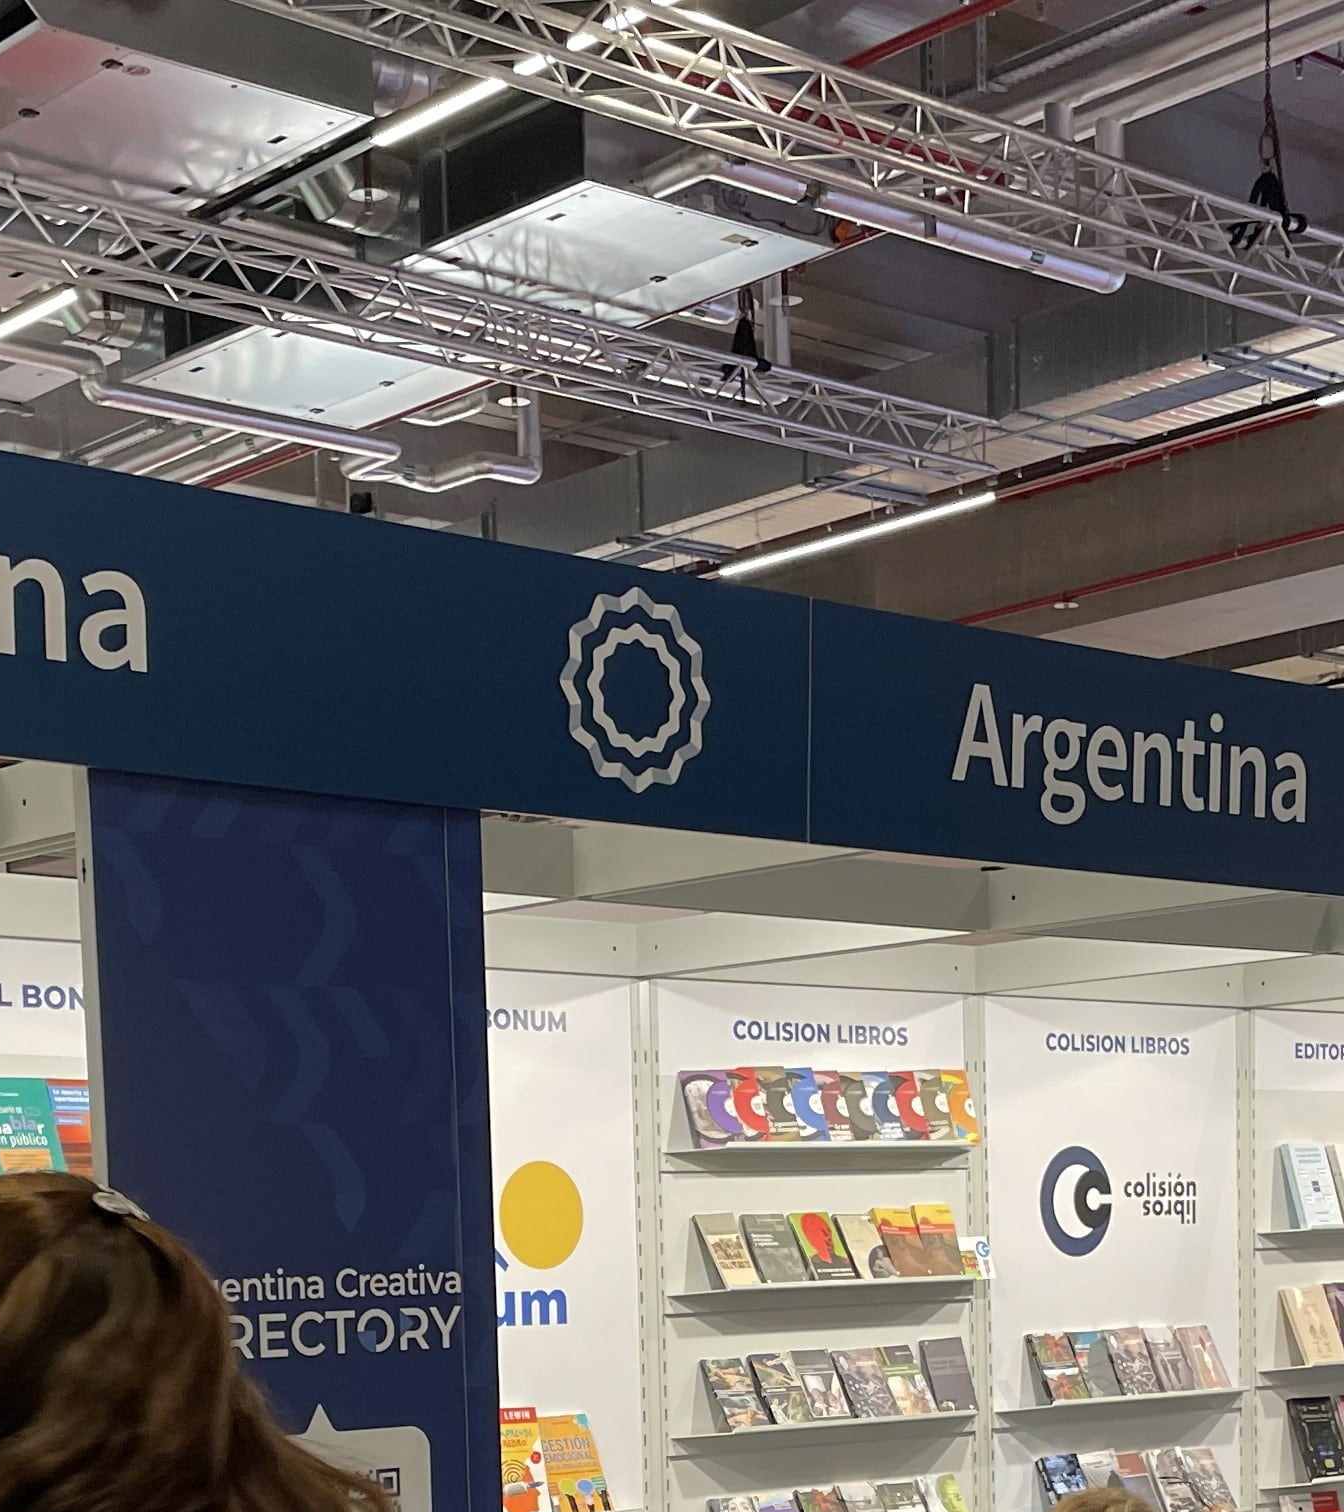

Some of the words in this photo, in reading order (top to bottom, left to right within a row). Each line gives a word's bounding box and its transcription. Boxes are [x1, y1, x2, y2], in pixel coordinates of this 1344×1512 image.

[952, 683, 1308, 825] Argentina
[733, 1020, 830, 1043] COLISION
[837, 1024, 908, 1046] LIBROS
[1046, 1033, 1126, 1053] COLISION
[1131, 1036, 1190, 1055] LIBROS
[10, 1132, 48, 1149] público
[1123, 1172, 1197, 1197] colisión
[214, 1268, 324, 1302] entina
[335, 1263, 461, 1299] Creativa
